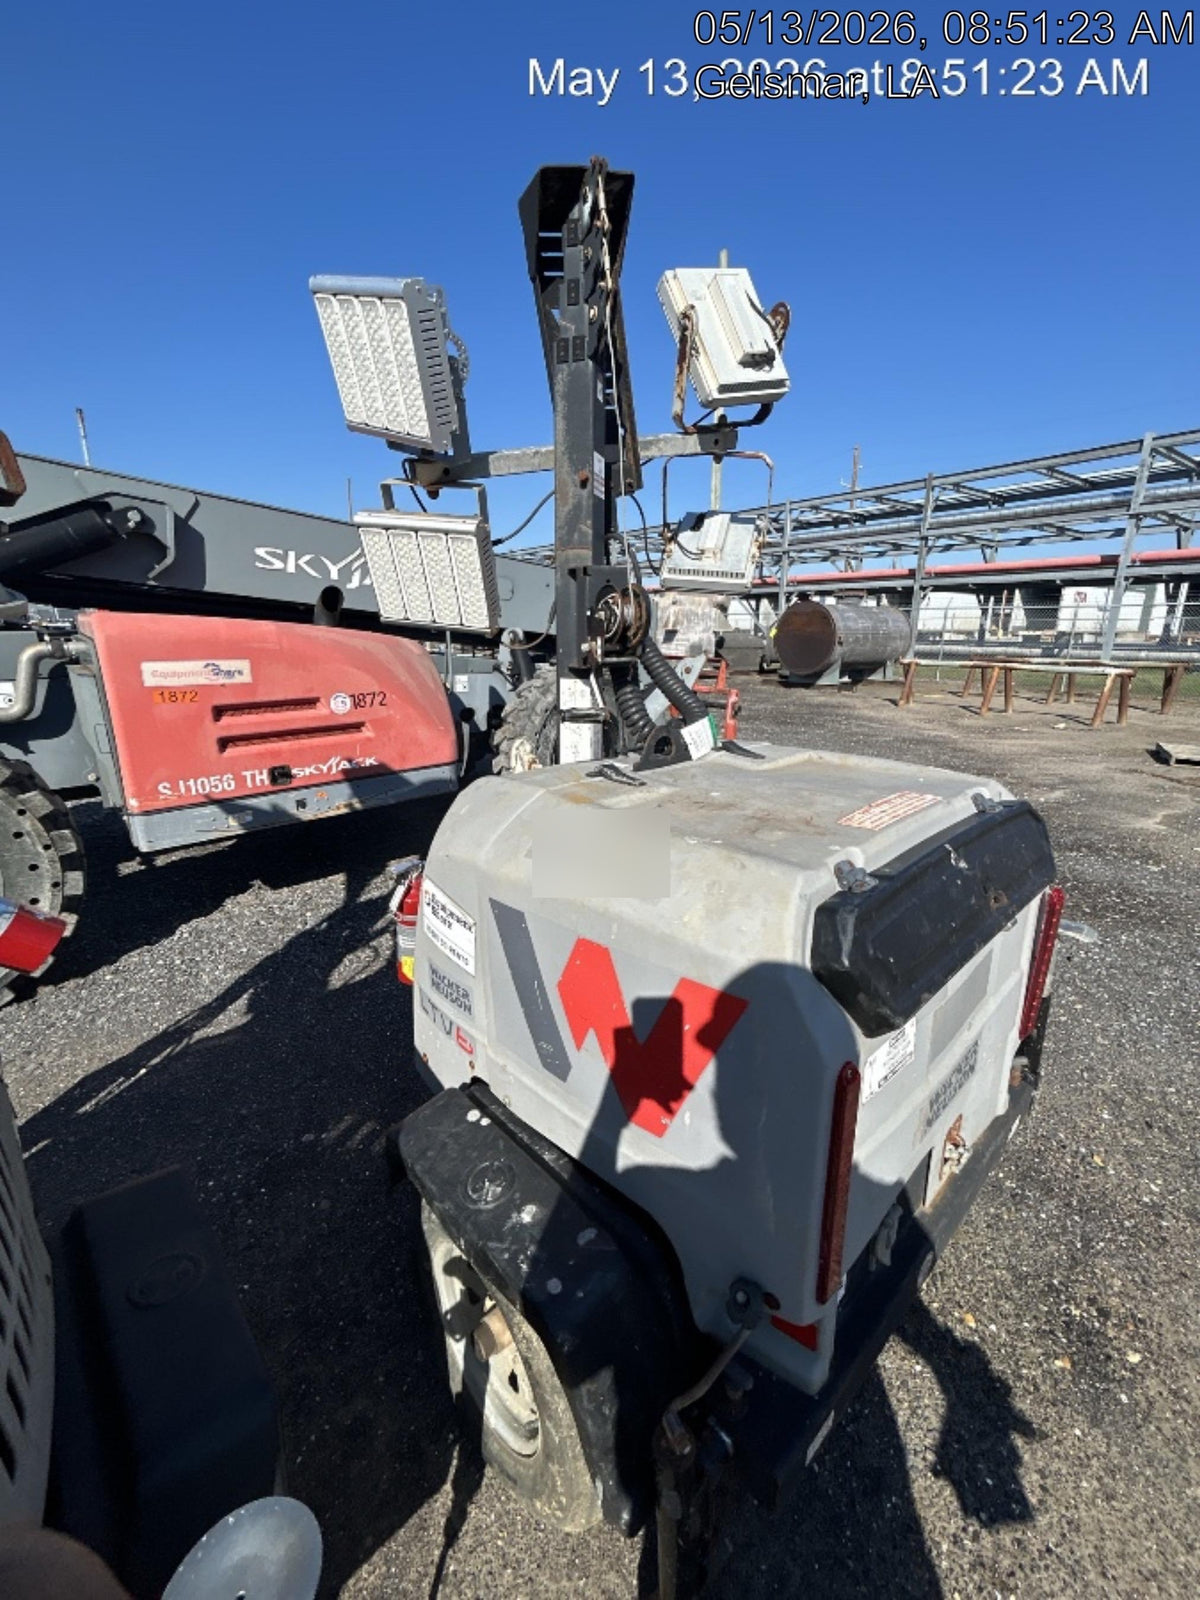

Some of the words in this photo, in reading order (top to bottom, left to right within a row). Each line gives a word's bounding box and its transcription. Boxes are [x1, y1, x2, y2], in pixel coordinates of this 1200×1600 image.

[159, 690, 199, 703] 1872
[349, 691, 387, 710] 1872
[291, 756, 378, 777] SKYJACK
